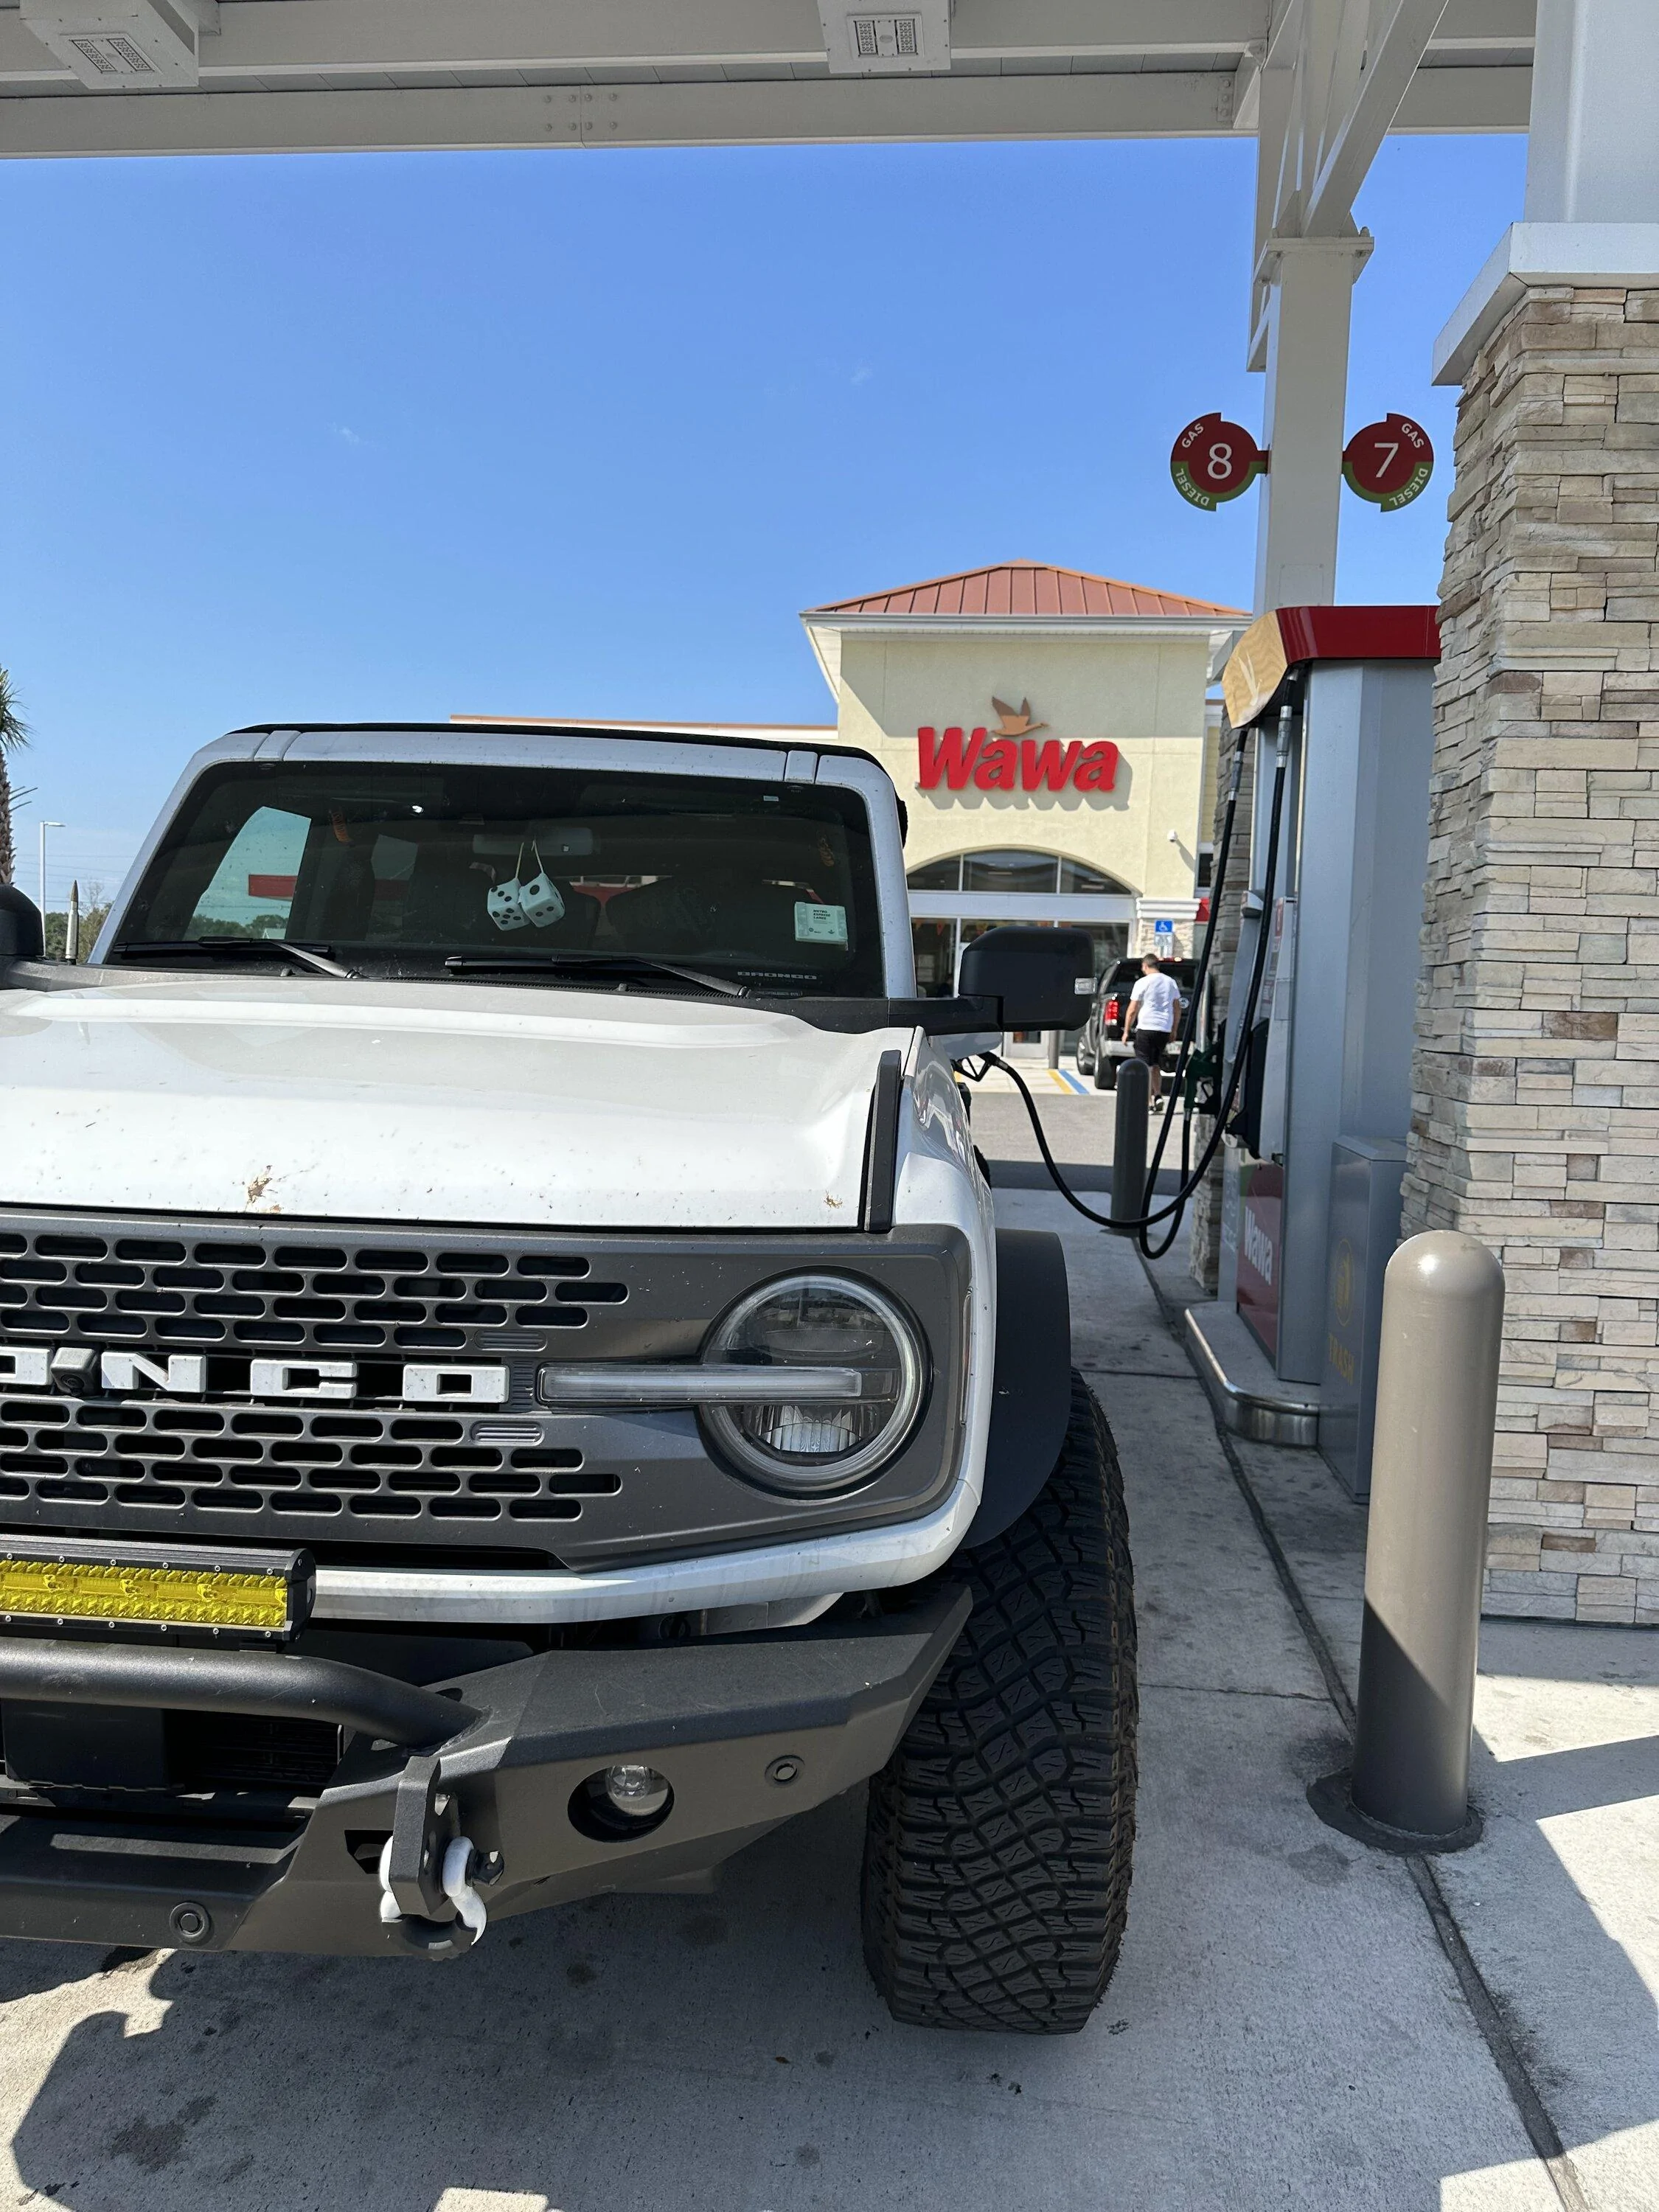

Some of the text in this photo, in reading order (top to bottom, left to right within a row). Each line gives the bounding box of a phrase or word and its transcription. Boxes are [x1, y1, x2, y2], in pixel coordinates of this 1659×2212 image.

[1181, 422, 1204, 448] GAS
[1401, 422, 1425, 449] GAS
[1207, 442, 1232, 480] 8
[1374, 442, 1399, 478] 7
[1175, 468, 1210, 506] DIESEL
[1388, 467, 1428, 506] DIESEL
[918, 726, 1119, 791] Wawa
[737, 971, 817, 980] BRONCO
[1244, 1206, 1273, 1286] Wawa
[1329, 1332, 1356, 1386] TRASH
